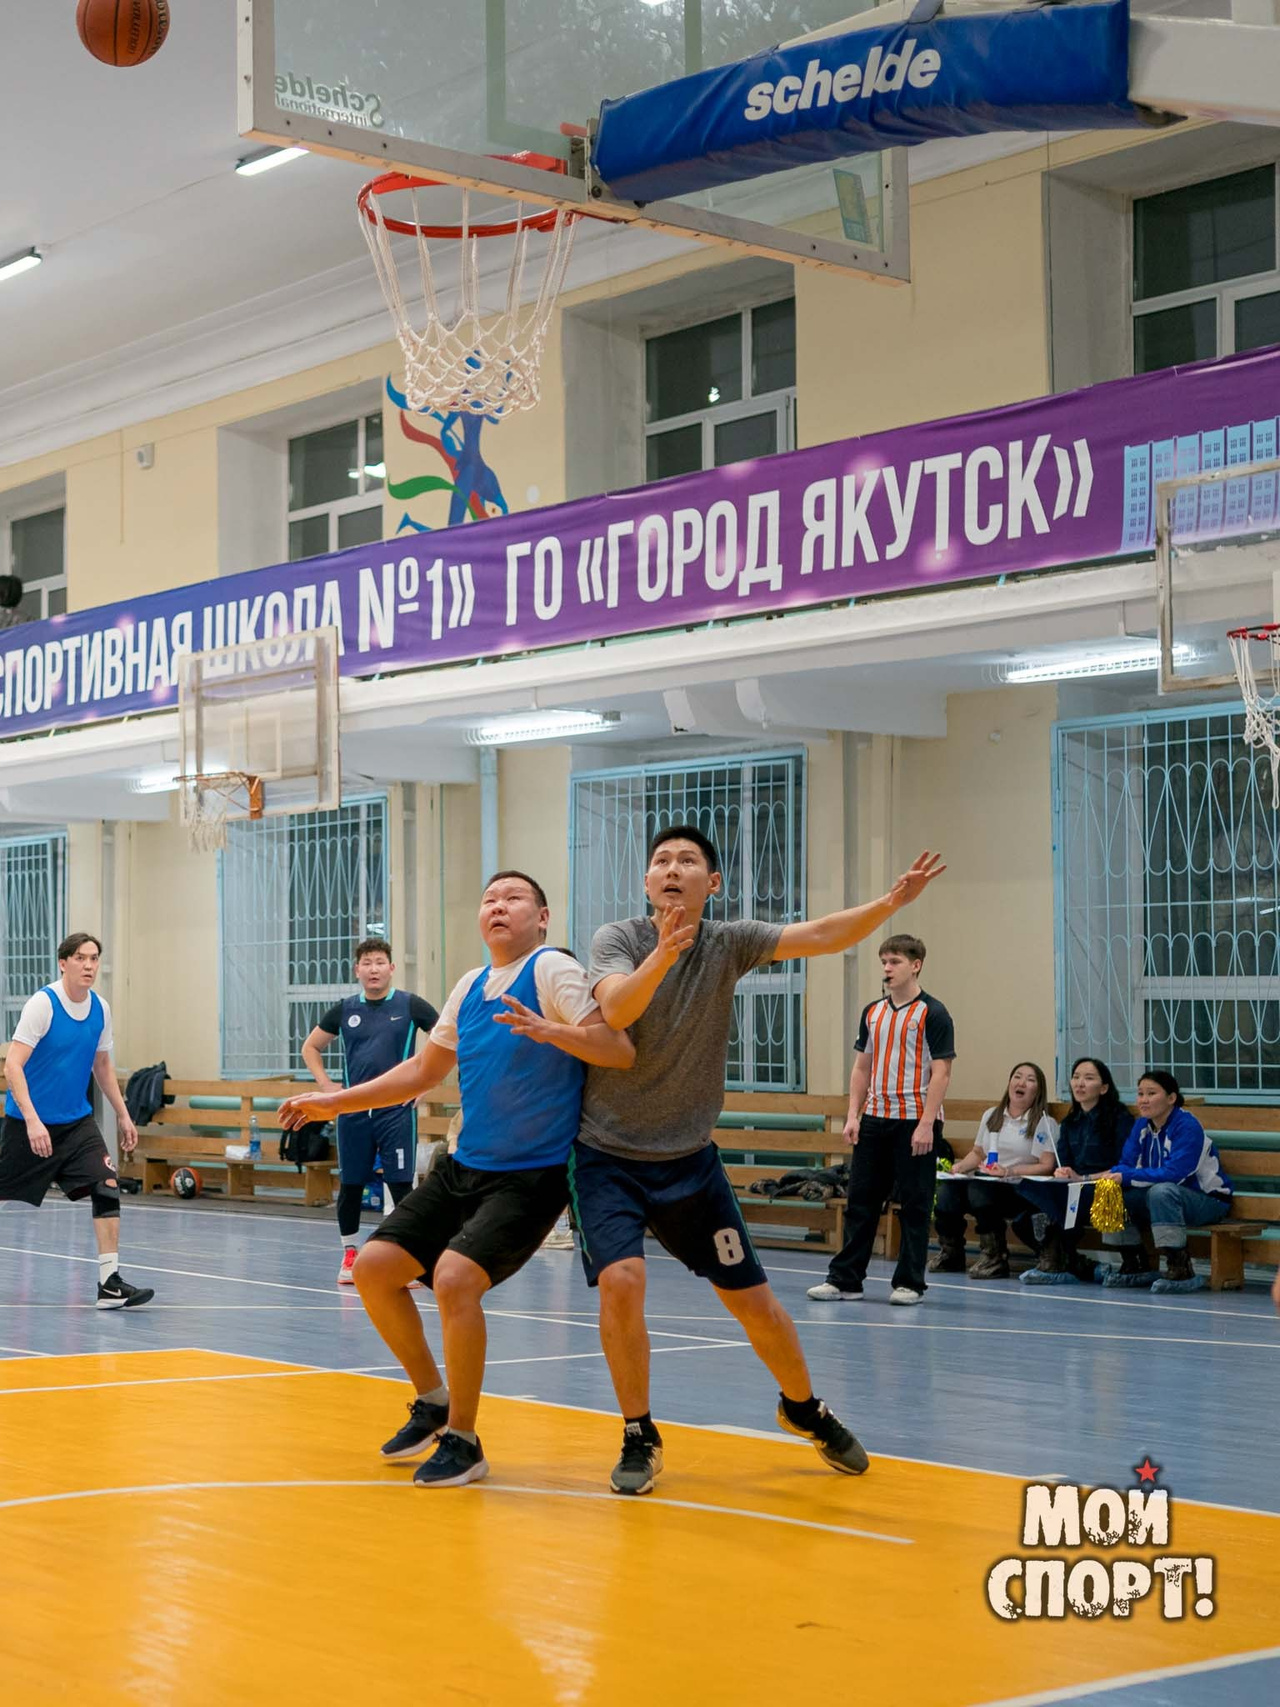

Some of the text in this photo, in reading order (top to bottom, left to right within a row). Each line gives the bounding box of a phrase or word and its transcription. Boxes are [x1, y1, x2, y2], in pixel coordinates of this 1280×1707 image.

[744, 38, 942, 121] schelde
[201, 579, 345, 680] ШКОЛА
[505, 536, 562, 626] ГО
[577, 490, 783, 608] «ГОРОД
[800, 434, 1094, 574] ЯКУТСК»
[395, 1148, 406, 1170] 1
[713, 1227, 746, 1266] 8
